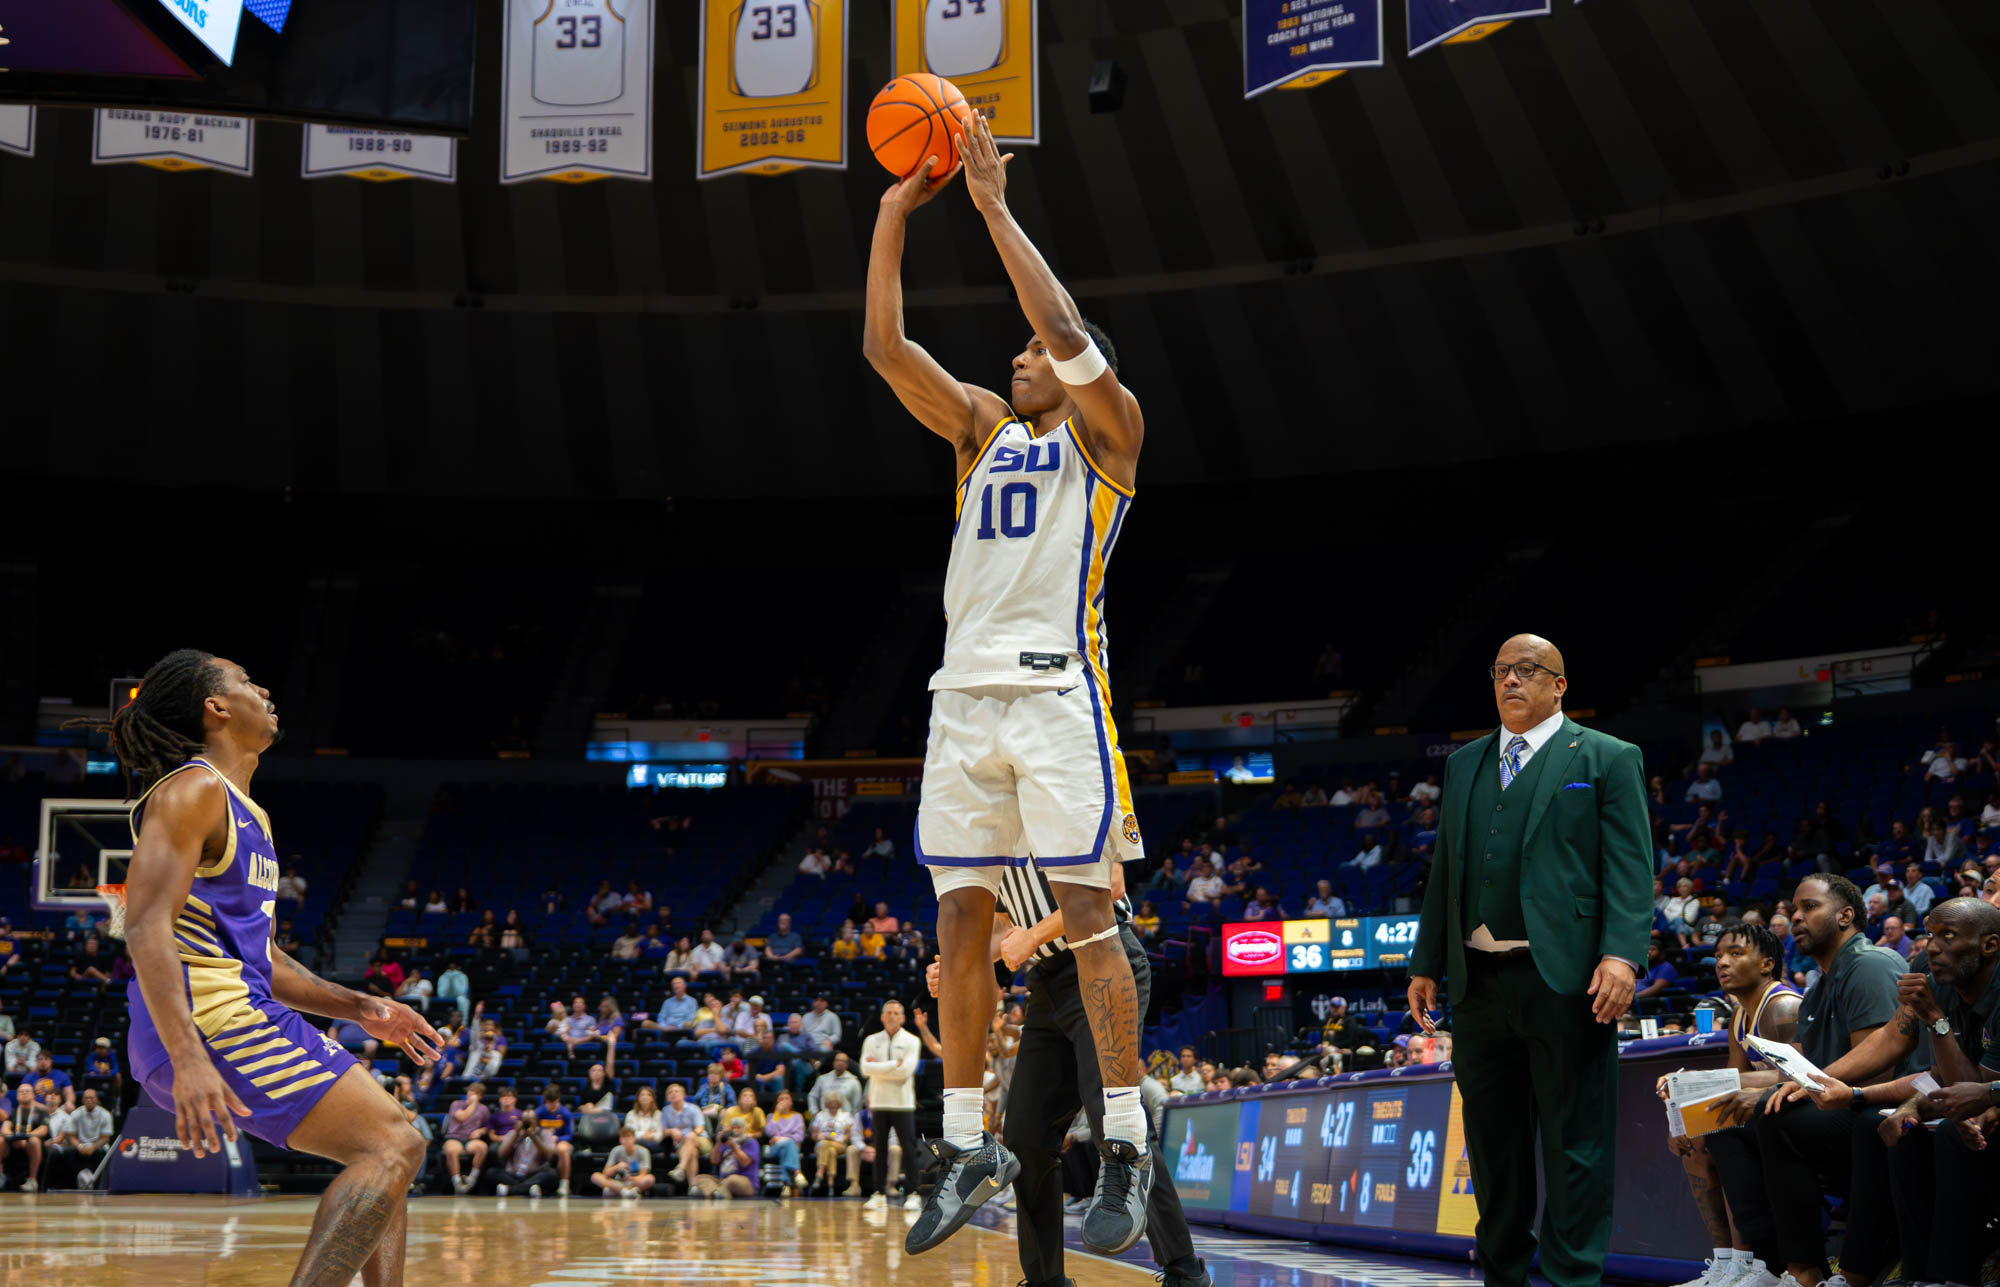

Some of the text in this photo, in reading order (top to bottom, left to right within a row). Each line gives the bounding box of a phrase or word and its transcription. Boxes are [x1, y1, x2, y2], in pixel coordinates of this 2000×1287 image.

[752, 4, 796, 40] 33
[1301, 4, 1344, 24] NATIONAL
[556, 14, 602, 49] 33
[1267, 12, 1355, 45] COACH OF THE YEAR
[1309, 36, 1334, 52] WINS
[967, 93, 1001, 105] OWLES
[145, 125, 204, 142] 1976-81
[349, 137, 412, 152] 1988-90
[530, 128, 584, 138] SHAQUILLE
[739, 129, 805, 147] 2002-06
[545, 139, 608, 154] 1989-92
[977, 482, 1038, 540] 10
[1375, 921, 1420, 943] 4:27
[1292, 945, 1322, 969] 36
[1320, 1101, 1355, 1147] 4:27
[138, 1147, 178, 1161] Share
[139, 1136, 210, 1149] Equip
[1235, 1142, 1254, 1171] LSU
[1258, 1136, 1277, 1182] 34
[1406, 1130, 1435, 1188] 36
[1290, 1170, 1300, 1207] 4
[1340, 1180, 1347, 1212] 1
[1359, 1172, 1371, 1213] 8
